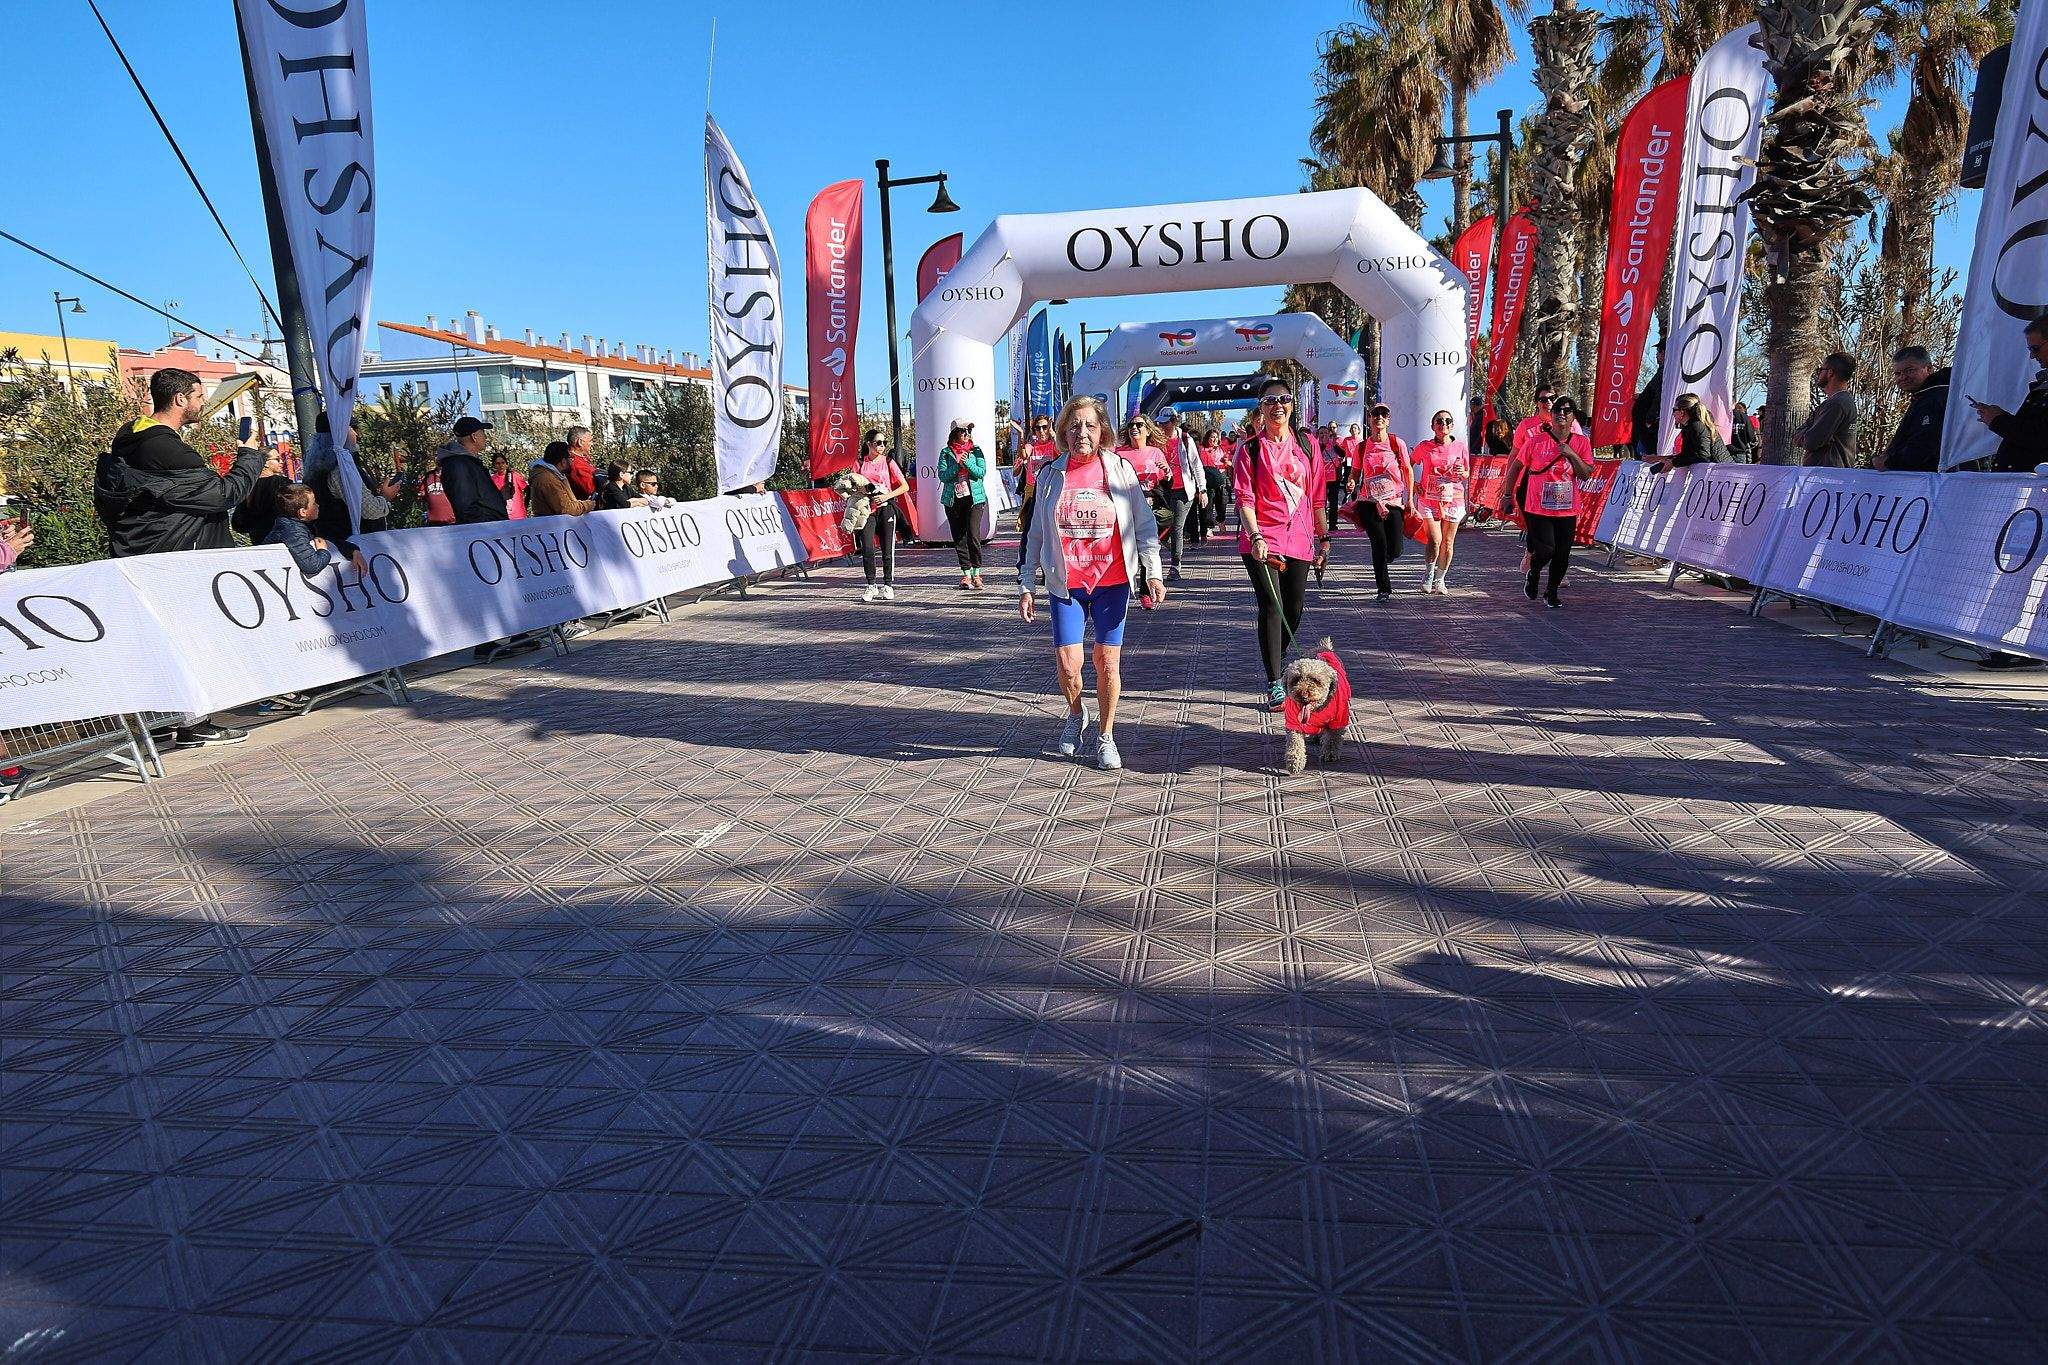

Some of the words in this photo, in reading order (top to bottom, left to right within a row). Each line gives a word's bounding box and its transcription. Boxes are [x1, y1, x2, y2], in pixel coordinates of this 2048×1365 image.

[1066, 214, 1290, 272] OYSHO
[1680, 86, 1751, 385] OYSHO
[826, 216, 848, 343] Santander
[1356, 254, 1427, 274] OYSHO
[1498, 232, 1529, 339] Santander
[1603, 332, 1628, 423] Sports
[1621, 123, 1673, 285] Santander
[941, 286, 1005, 302] OYSHO
[1395, 350, 1461, 369] OYSHO
[918, 376, 975, 393] OYSHO
[1178, 382, 1252, 394] VOLVO
[824, 381, 850, 455] Sports
[724, 503, 785, 540] OYSHO
[1076, 510, 1098, 519] 016
[1685, 478, 1767, 527] OYSHO
[1801, 488, 1930, 555] OYSHO
[468, 528, 588, 586] OYSHO
[620, 512, 701, 558] OYSHO
[211, 552, 410, 630] OYSHO
[296, 625, 387, 653] WWW.OYSHO.COM
[0, 667, 73, 690] HO.COM
